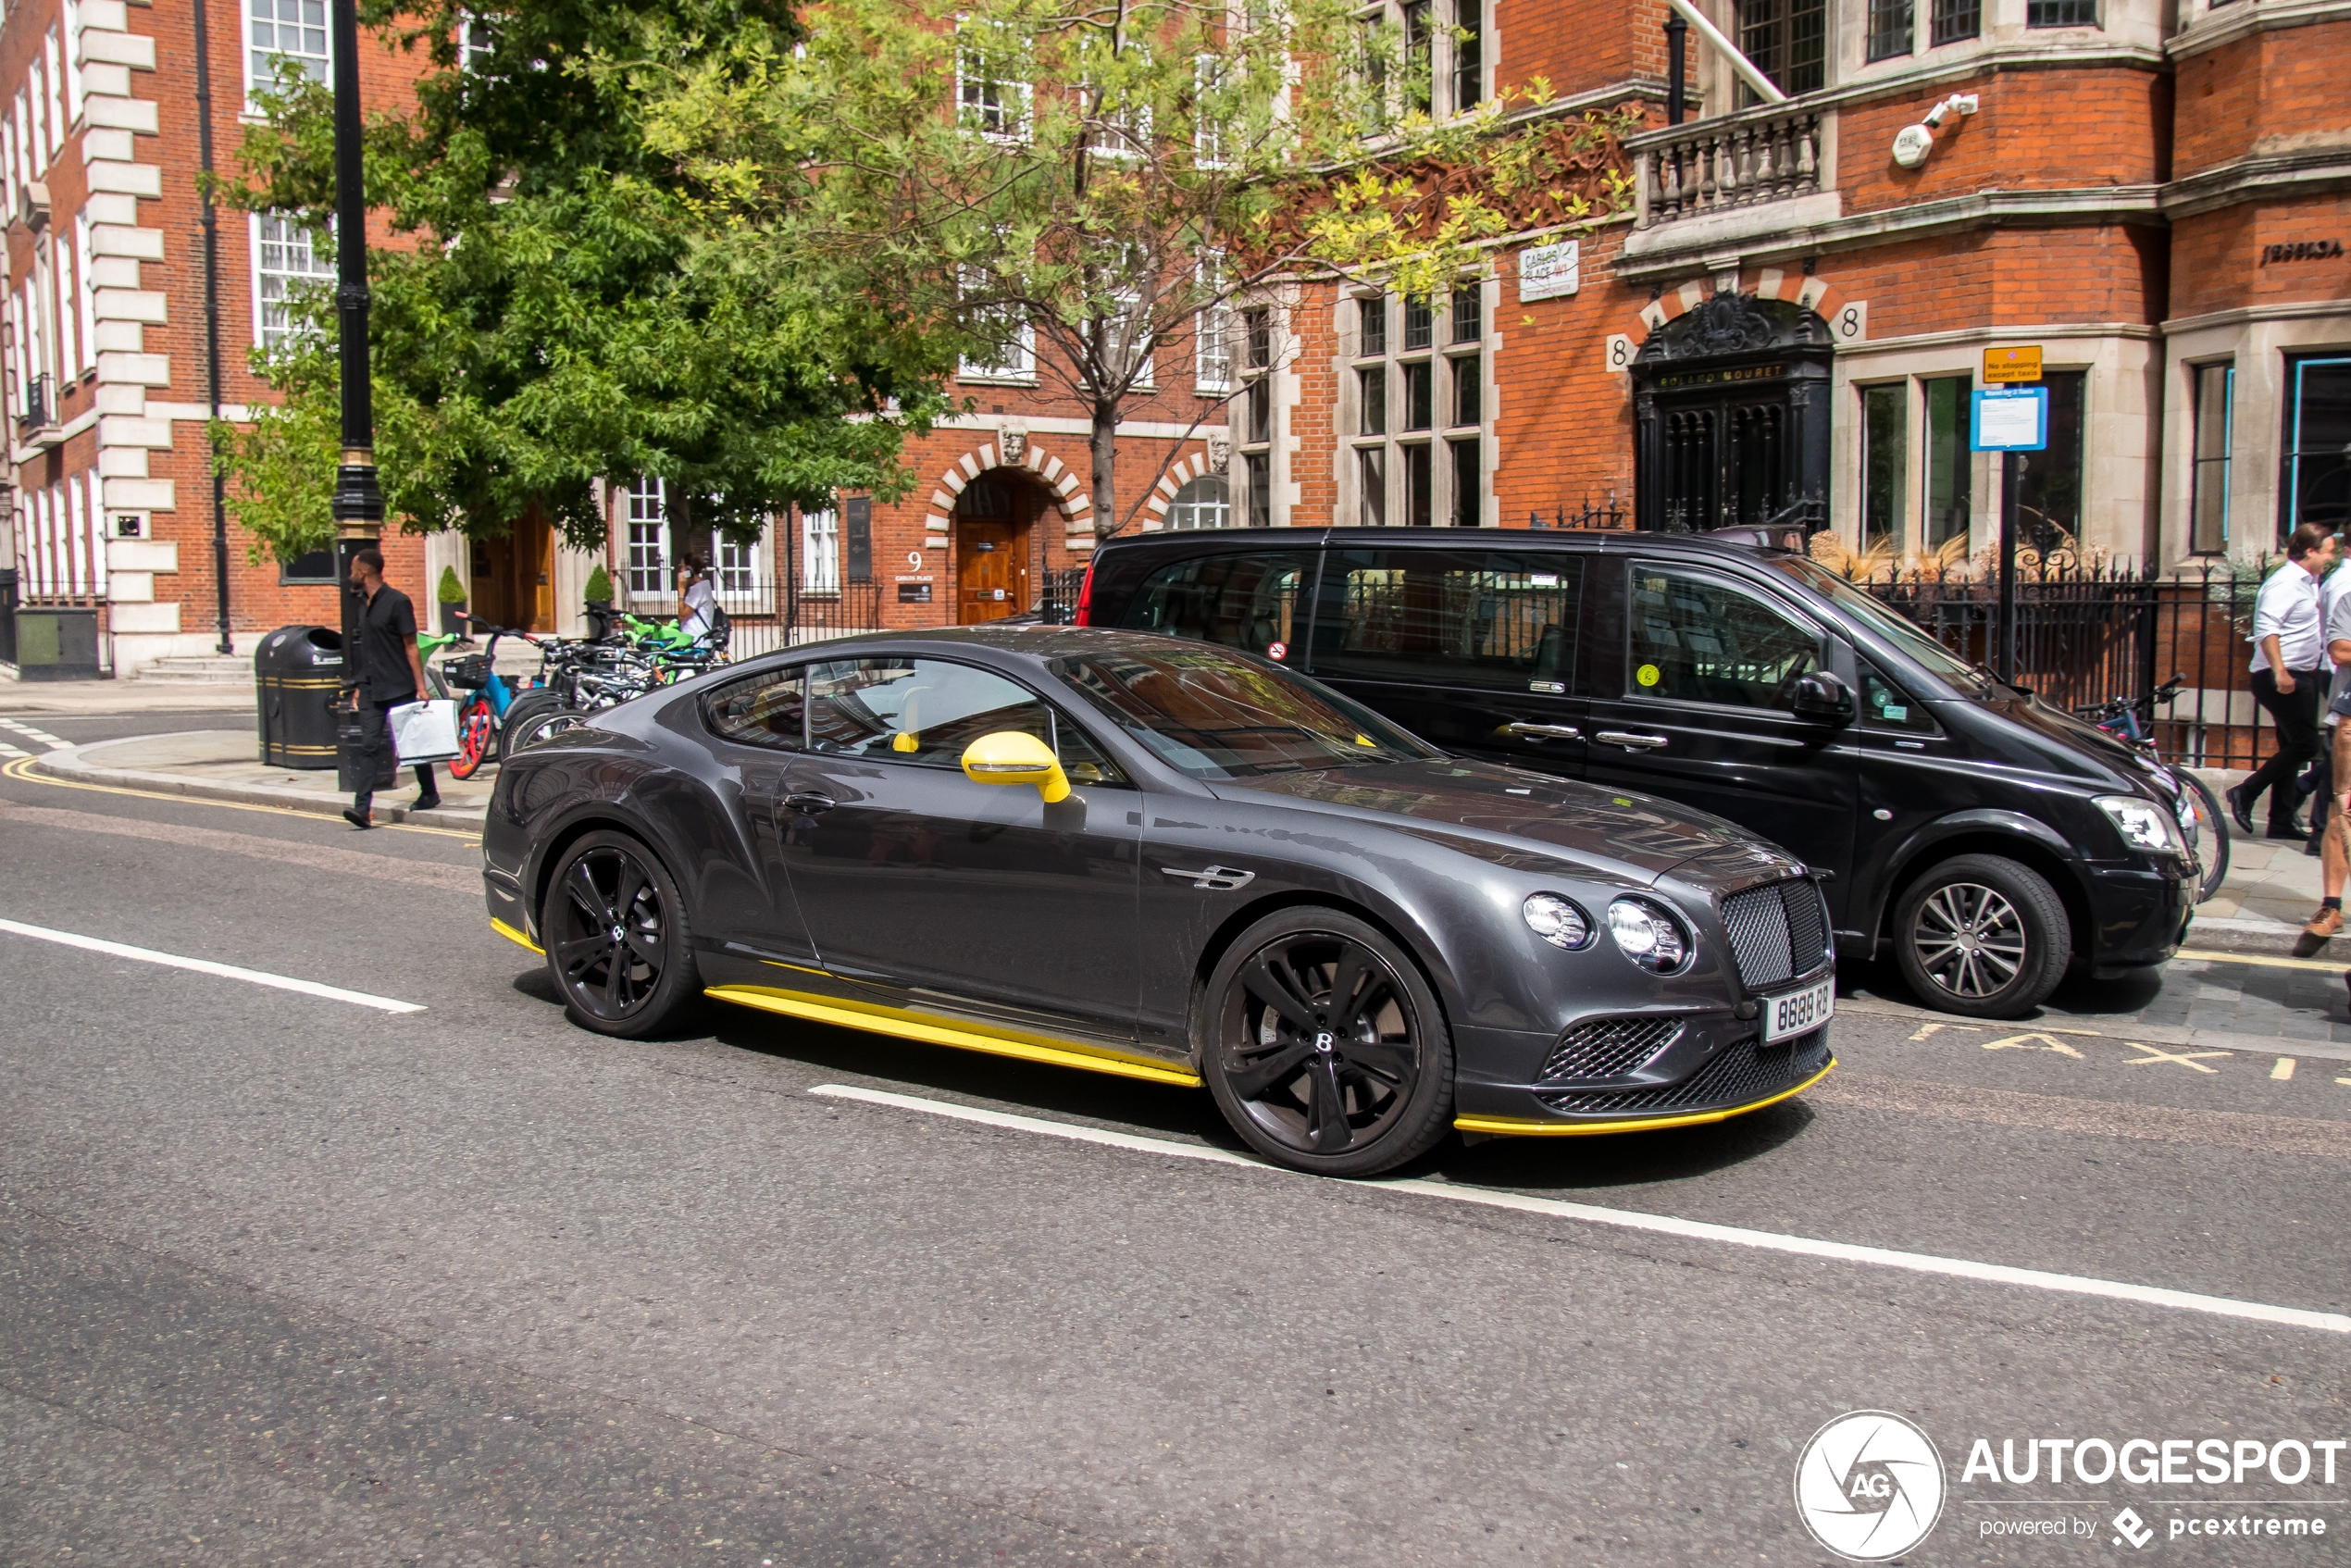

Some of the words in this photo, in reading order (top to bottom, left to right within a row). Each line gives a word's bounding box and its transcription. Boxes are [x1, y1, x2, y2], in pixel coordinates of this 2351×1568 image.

[1842, 308, 1858, 337] 8
[1613, 340, 1626, 365] 8
[1661, 373, 1715, 386] ROLAND
[1723, 366, 1781, 380] MOURET
[908, 552, 923, 573] 9
[1908, 1023, 2351, 1086] TAXI
